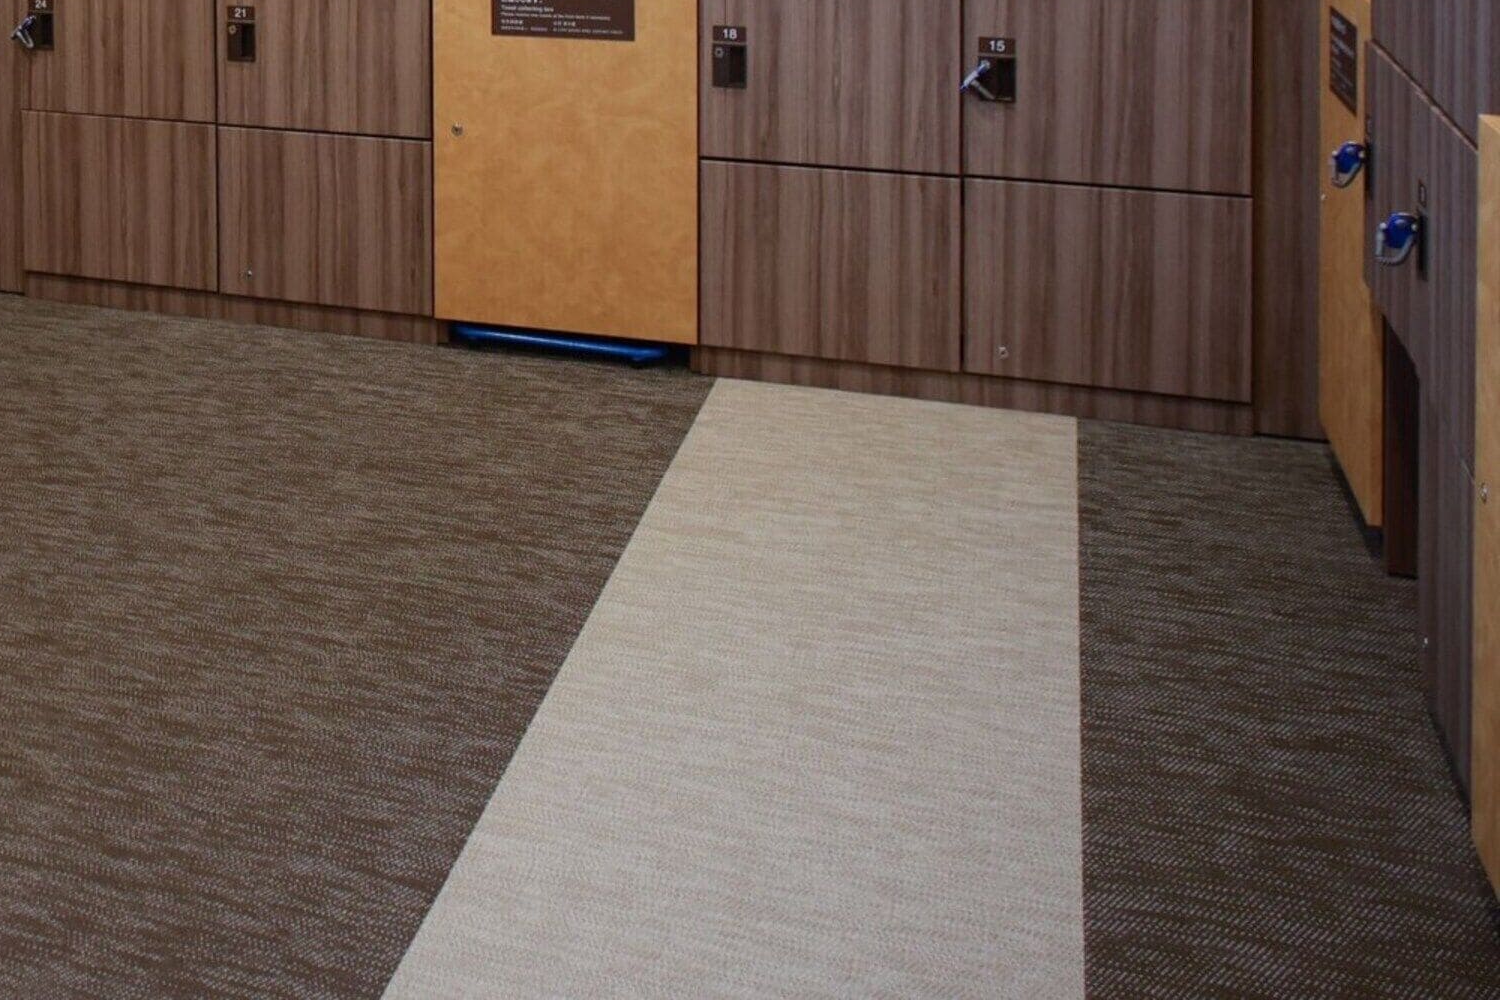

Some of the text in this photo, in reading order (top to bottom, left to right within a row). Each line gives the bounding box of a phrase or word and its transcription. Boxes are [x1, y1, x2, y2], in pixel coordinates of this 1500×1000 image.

[234, 7, 247, 18] 21
[722, 28, 738, 40] 18
[989, 39, 1006, 52] 15
